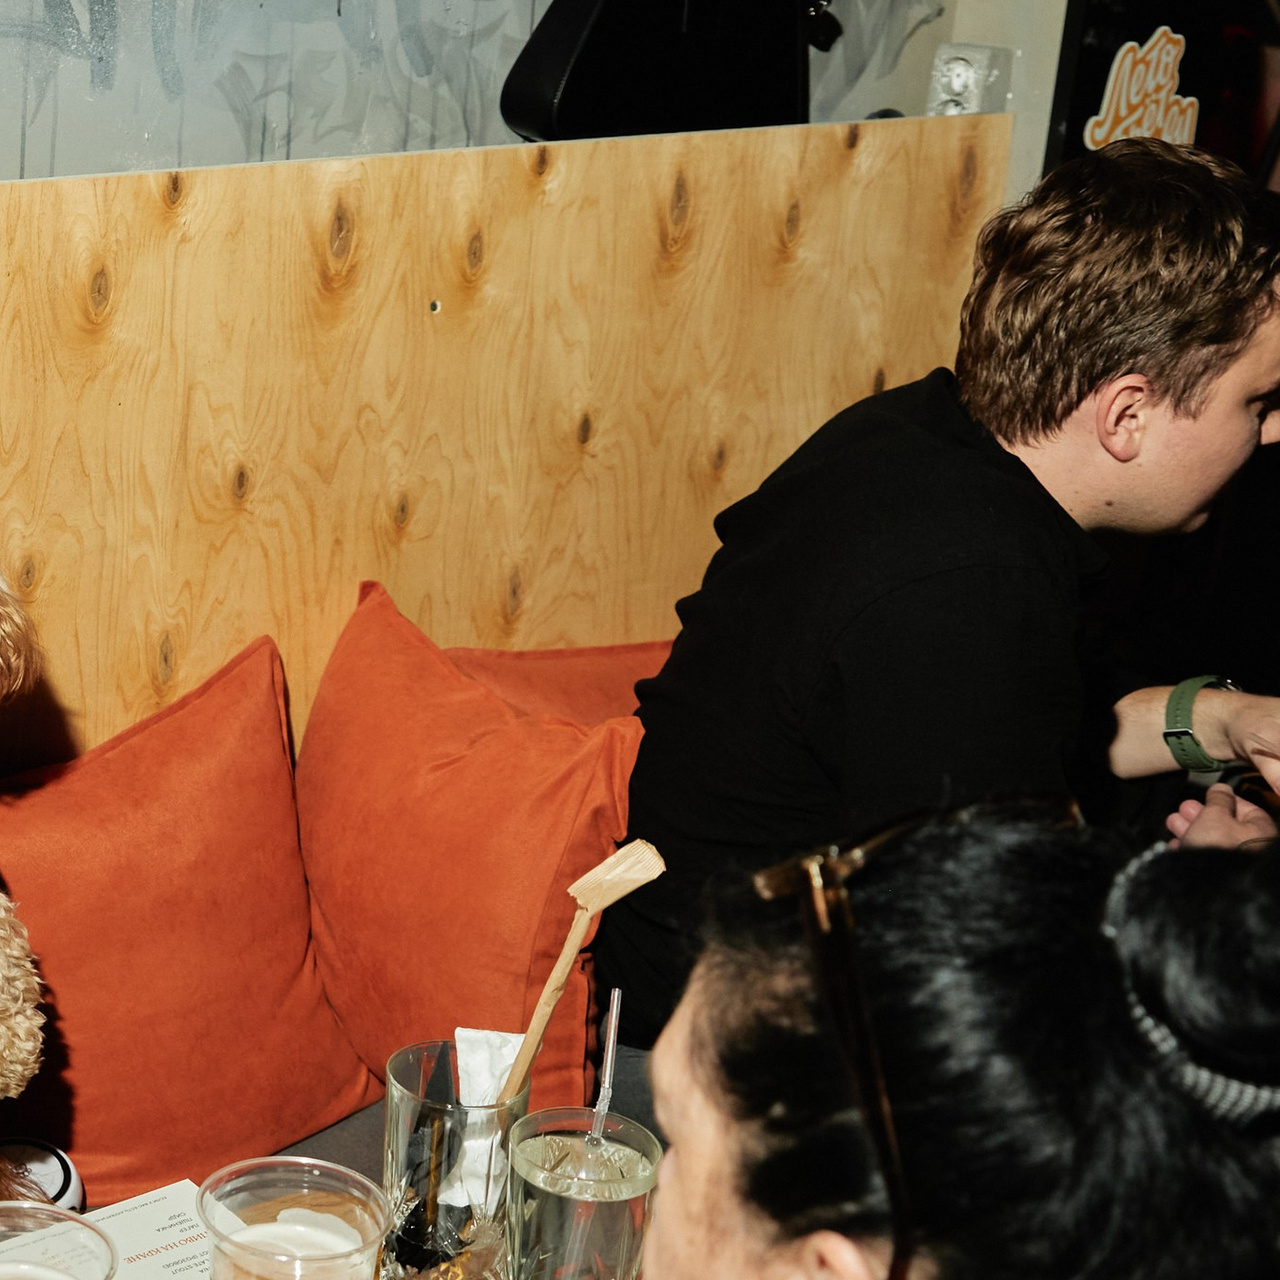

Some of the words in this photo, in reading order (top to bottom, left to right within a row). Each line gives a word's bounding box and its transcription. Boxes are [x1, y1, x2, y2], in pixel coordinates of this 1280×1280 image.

[160, 1241, 179, 1251] НА
[178, 1231, 208, 1246] ПИВО
[124, 1247, 162, 1264] КРАНЕ
